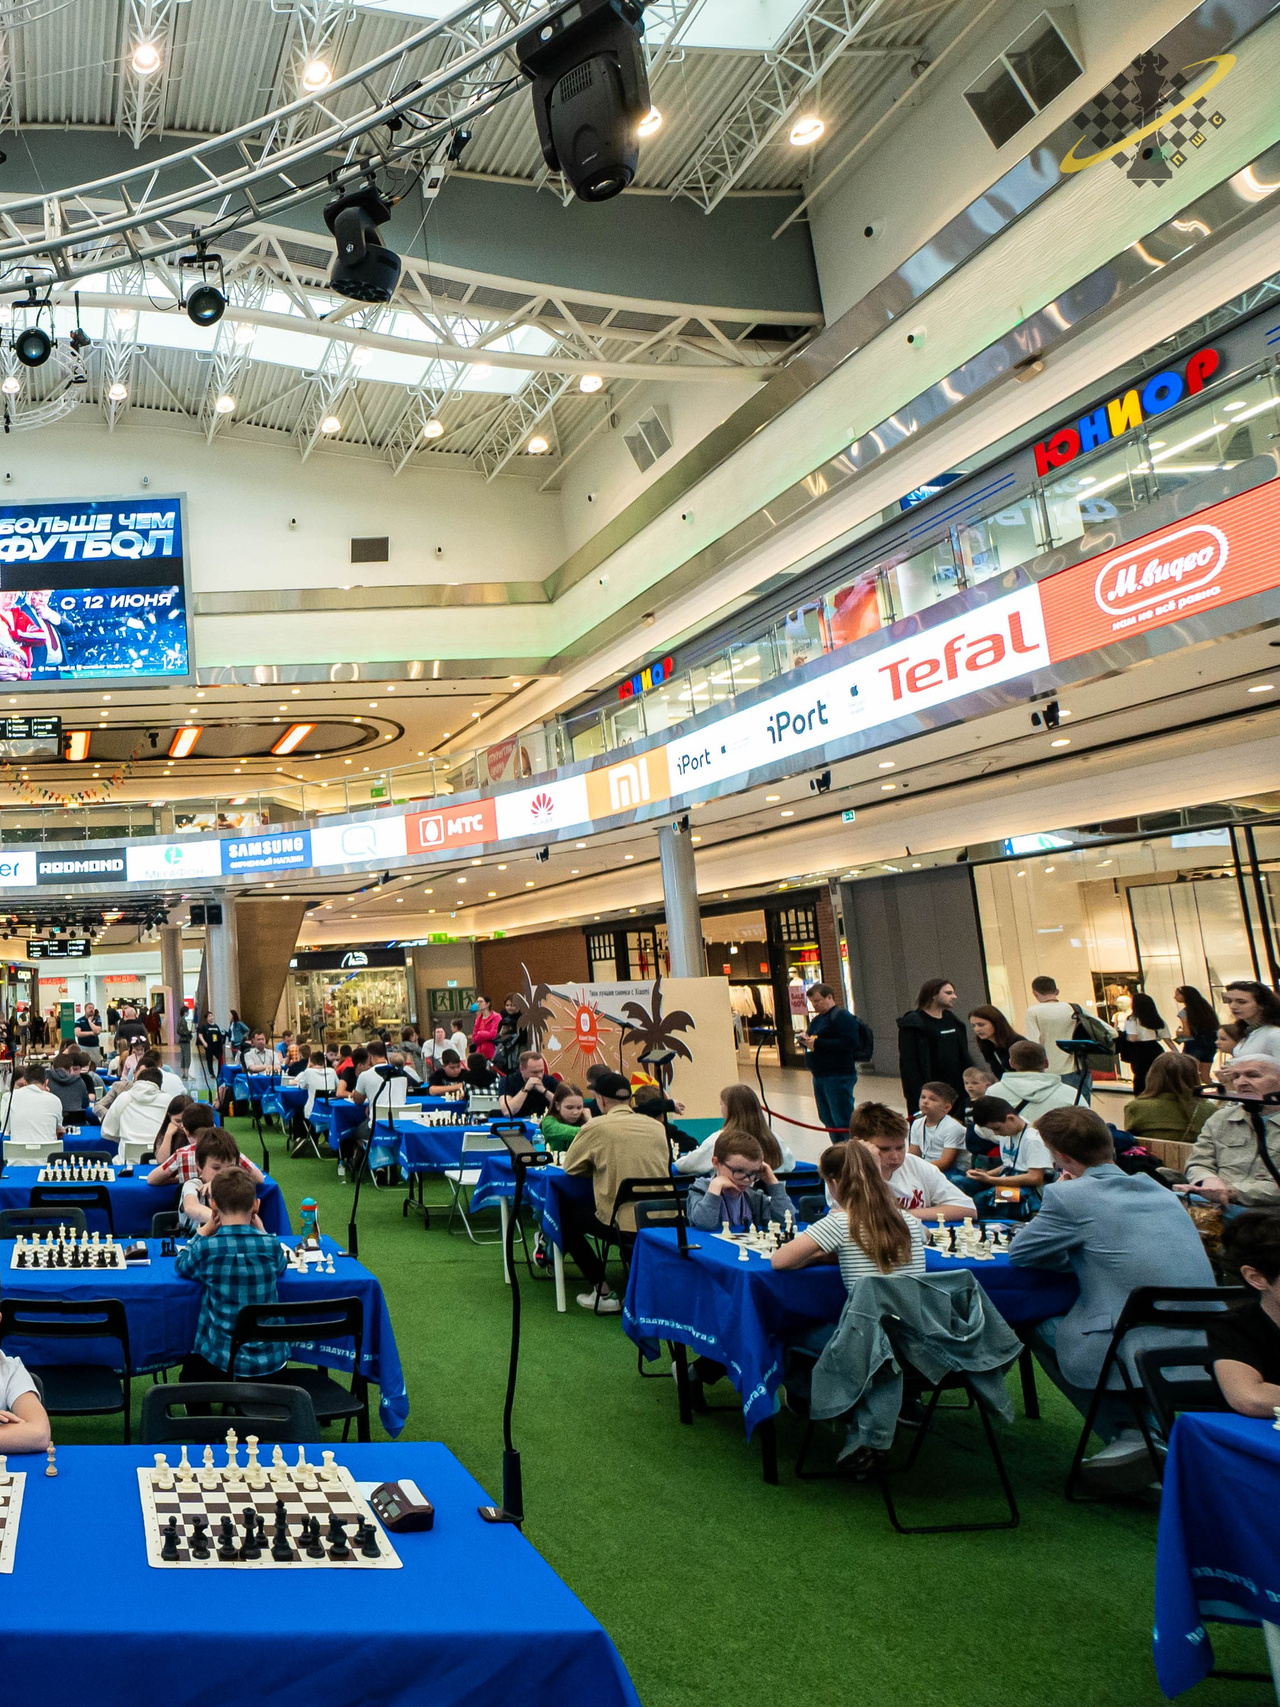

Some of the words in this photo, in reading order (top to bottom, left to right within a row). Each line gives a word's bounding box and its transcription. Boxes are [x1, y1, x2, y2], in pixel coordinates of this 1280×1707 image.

[1034, 348, 1219, 477] ЮНИОР
[119, 511, 176, 530] ЧЕМ
[83, 595, 104, 609] 12
[110, 593, 172, 609] ИЮНЯ
[162, 654, 183, 670] 12+
[878, 610, 1041, 702] Tefal
[767, 699, 829, 745] iPort
[677, 748, 712, 776] iPort
[447, 814, 484, 837] МТС
[228, 837, 304, 859] SAMSUNG
[39, 859, 124, 875] REDMOND
